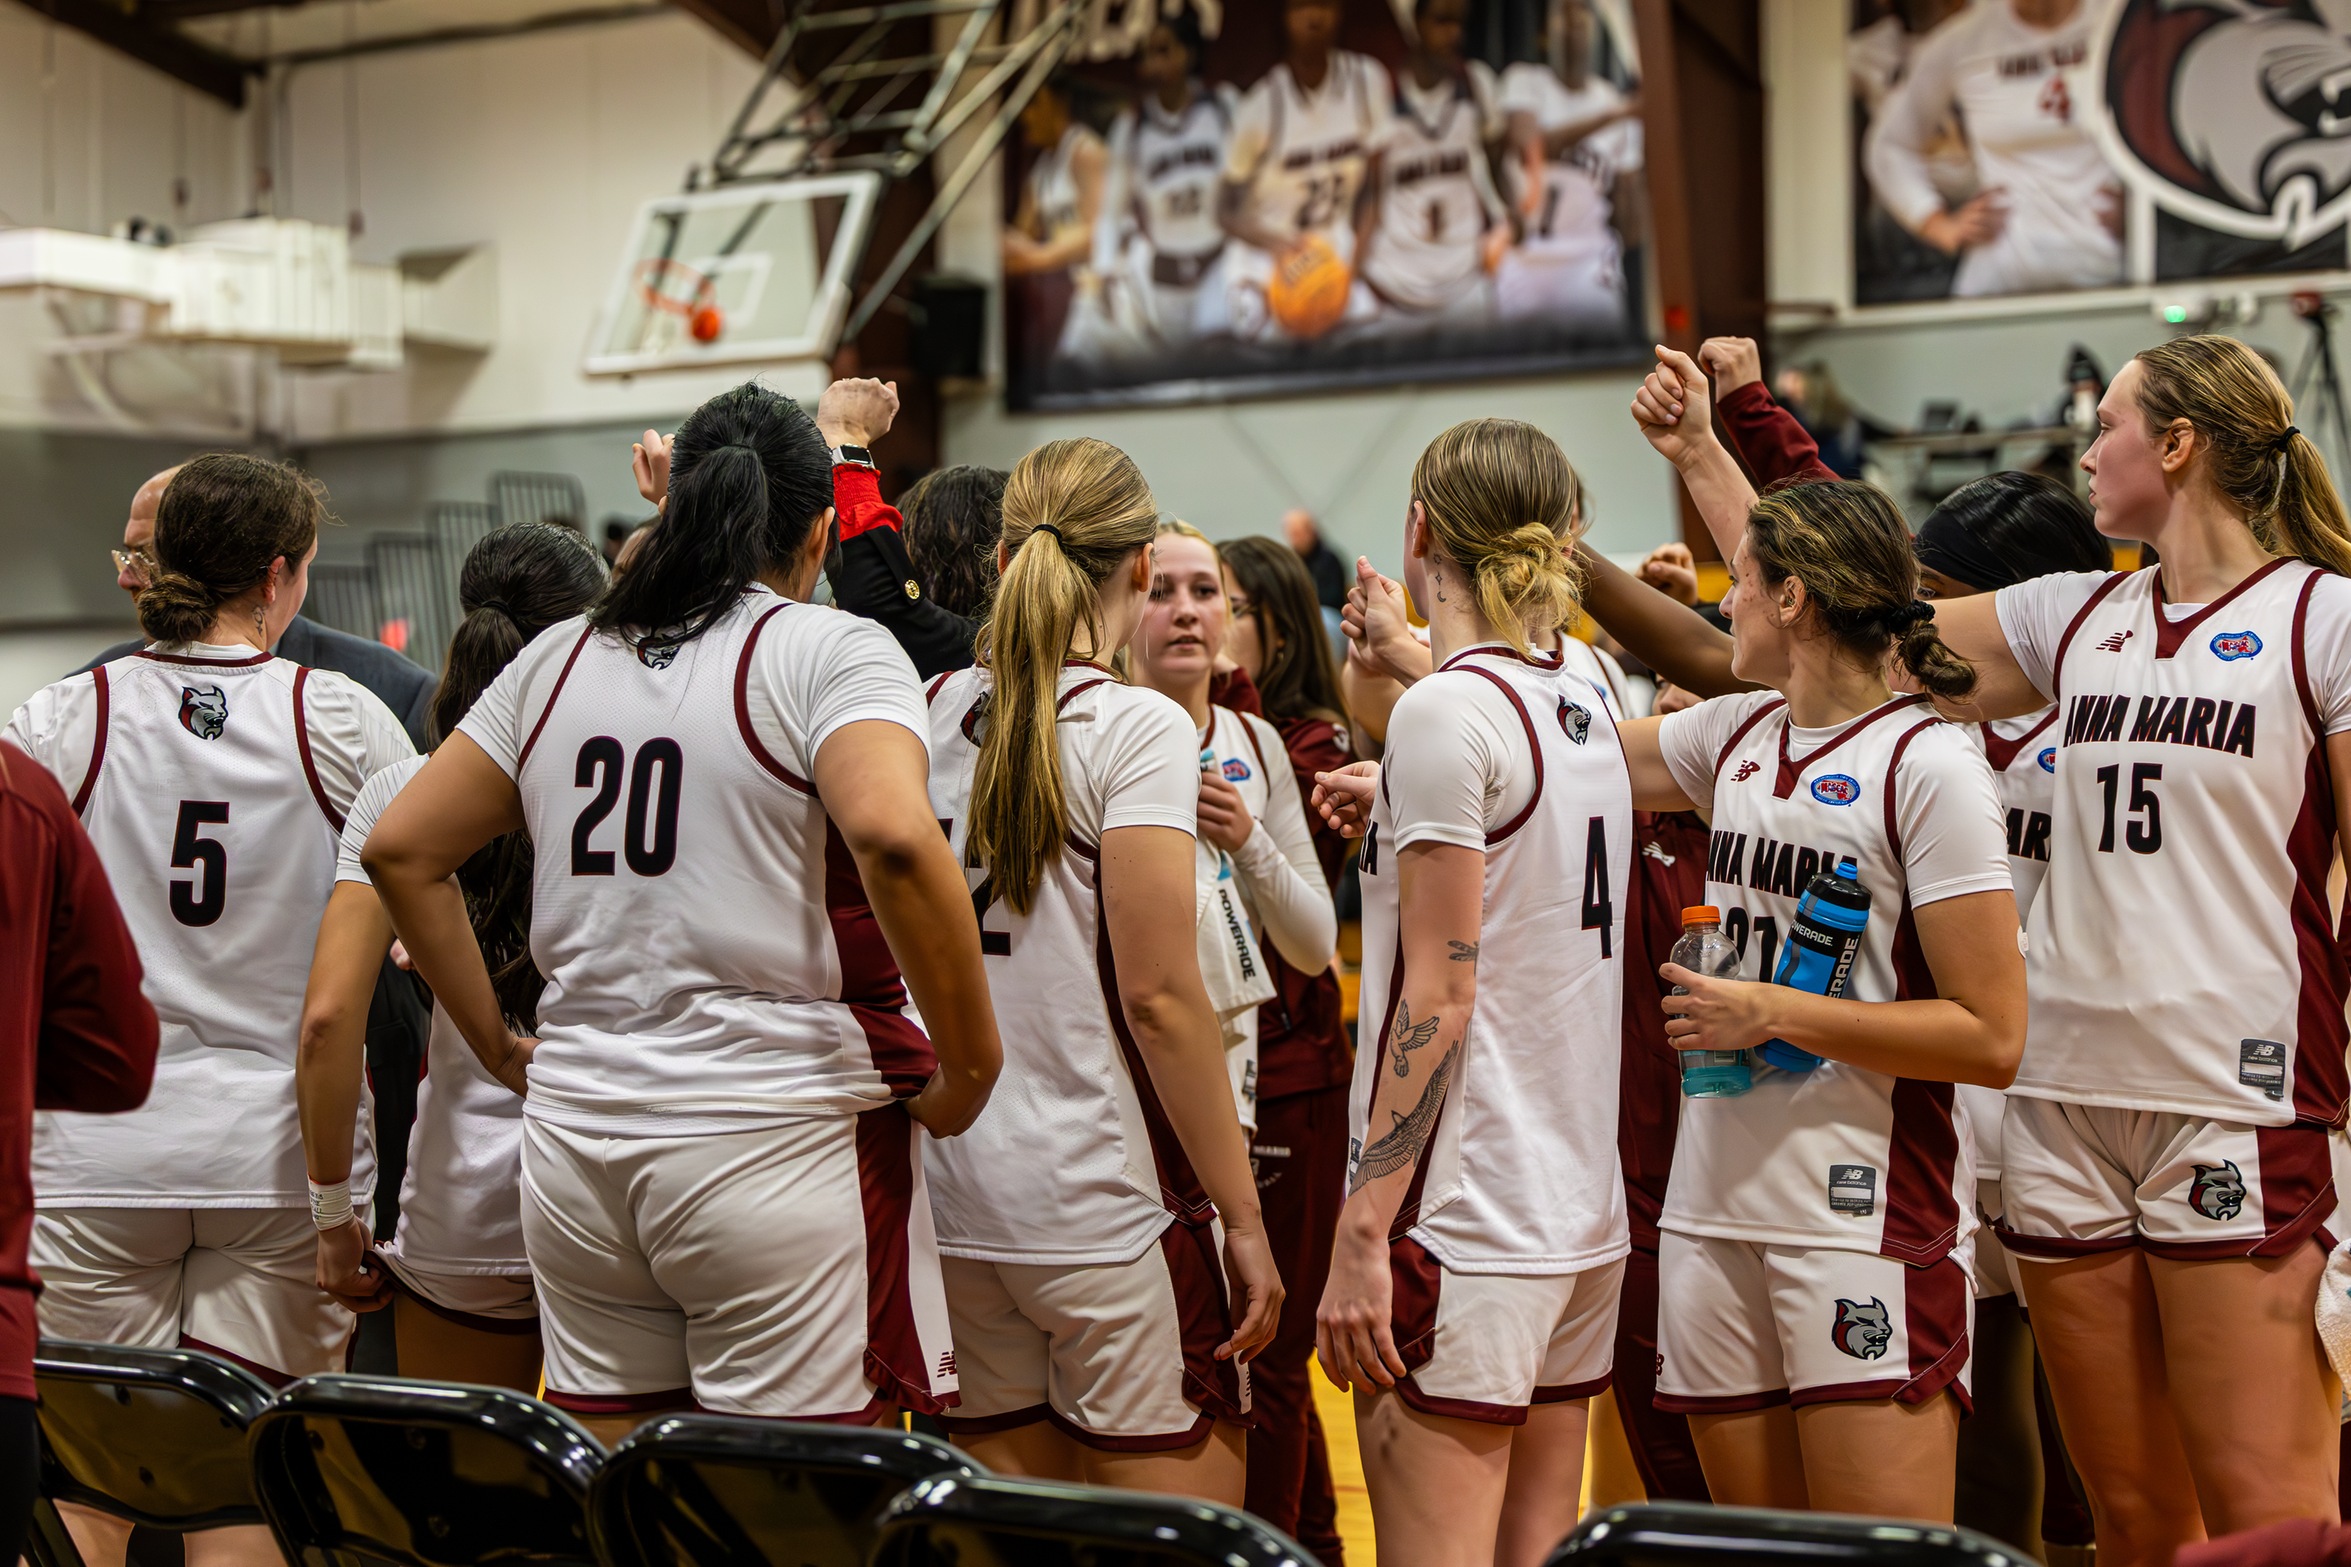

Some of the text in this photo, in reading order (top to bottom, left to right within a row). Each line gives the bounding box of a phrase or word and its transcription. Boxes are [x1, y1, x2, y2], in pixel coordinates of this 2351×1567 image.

[2128, 694, 2257, 759] MARIA
[571, 735, 683, 877] 20
[2097, 762, 2163, 855] 15
[169, 800, 230, 927] 5
[1581, 816, 1613, 959] 4
[1707, 829, 1748, 886] NNA
[1218, 888, 1257, 983] POWERADE
